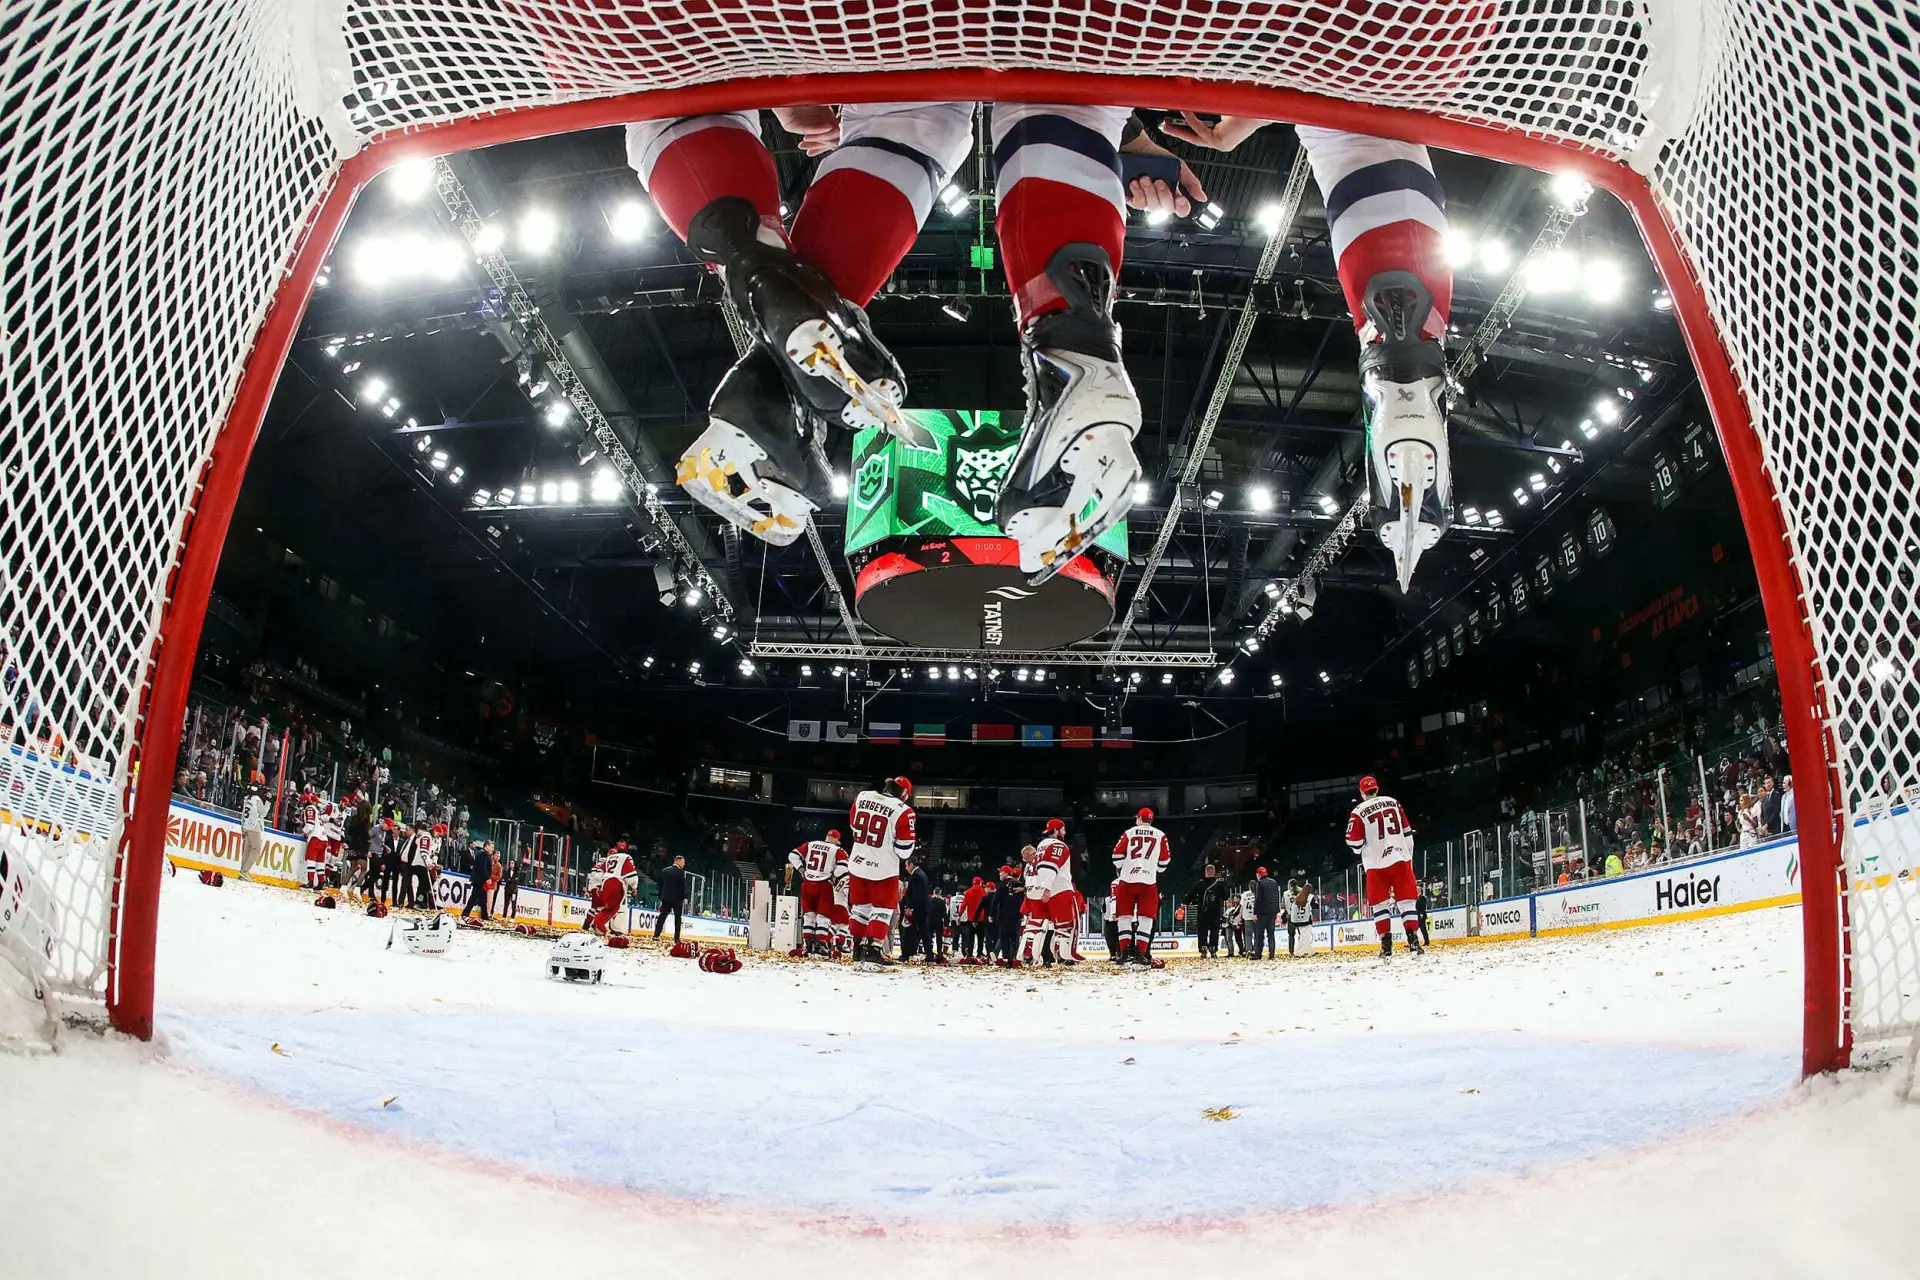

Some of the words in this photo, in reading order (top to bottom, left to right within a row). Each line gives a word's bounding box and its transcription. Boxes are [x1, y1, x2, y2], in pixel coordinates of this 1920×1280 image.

[1693, 439, 1704, 458] 4
[1656, 465, 1673, 491] 18
[1593, 521, 1607, 544] 10
[941, 552, 950, 563] 2
[975, 543, 1002, 551] 0:00.0
[1564, 544, 1576, 566] 15
[1541, 568, 1549, 586] 9
[1513, 584, 1526, 606] 25
[984, 601, 1003, 646] TATNEFT
[853, 811, 888, 848] 99
[1367, 808, 1400, 840] 73
[166, 814, 296, 874] ИНОПИСК
[1051, 848, 1063, 857] 38
[1130, 836, 1157, 860] 27
[807, 850, 828, 872] 51
[1656, 872, 1720, 910] Haier
[515, 904, 540, 916] ATNEFT
[1568, 903, 1600, 914] TATNEFT
[1434, 918, 1455, 930] БАНК
[1314, 932, 1328, 942] LADA
